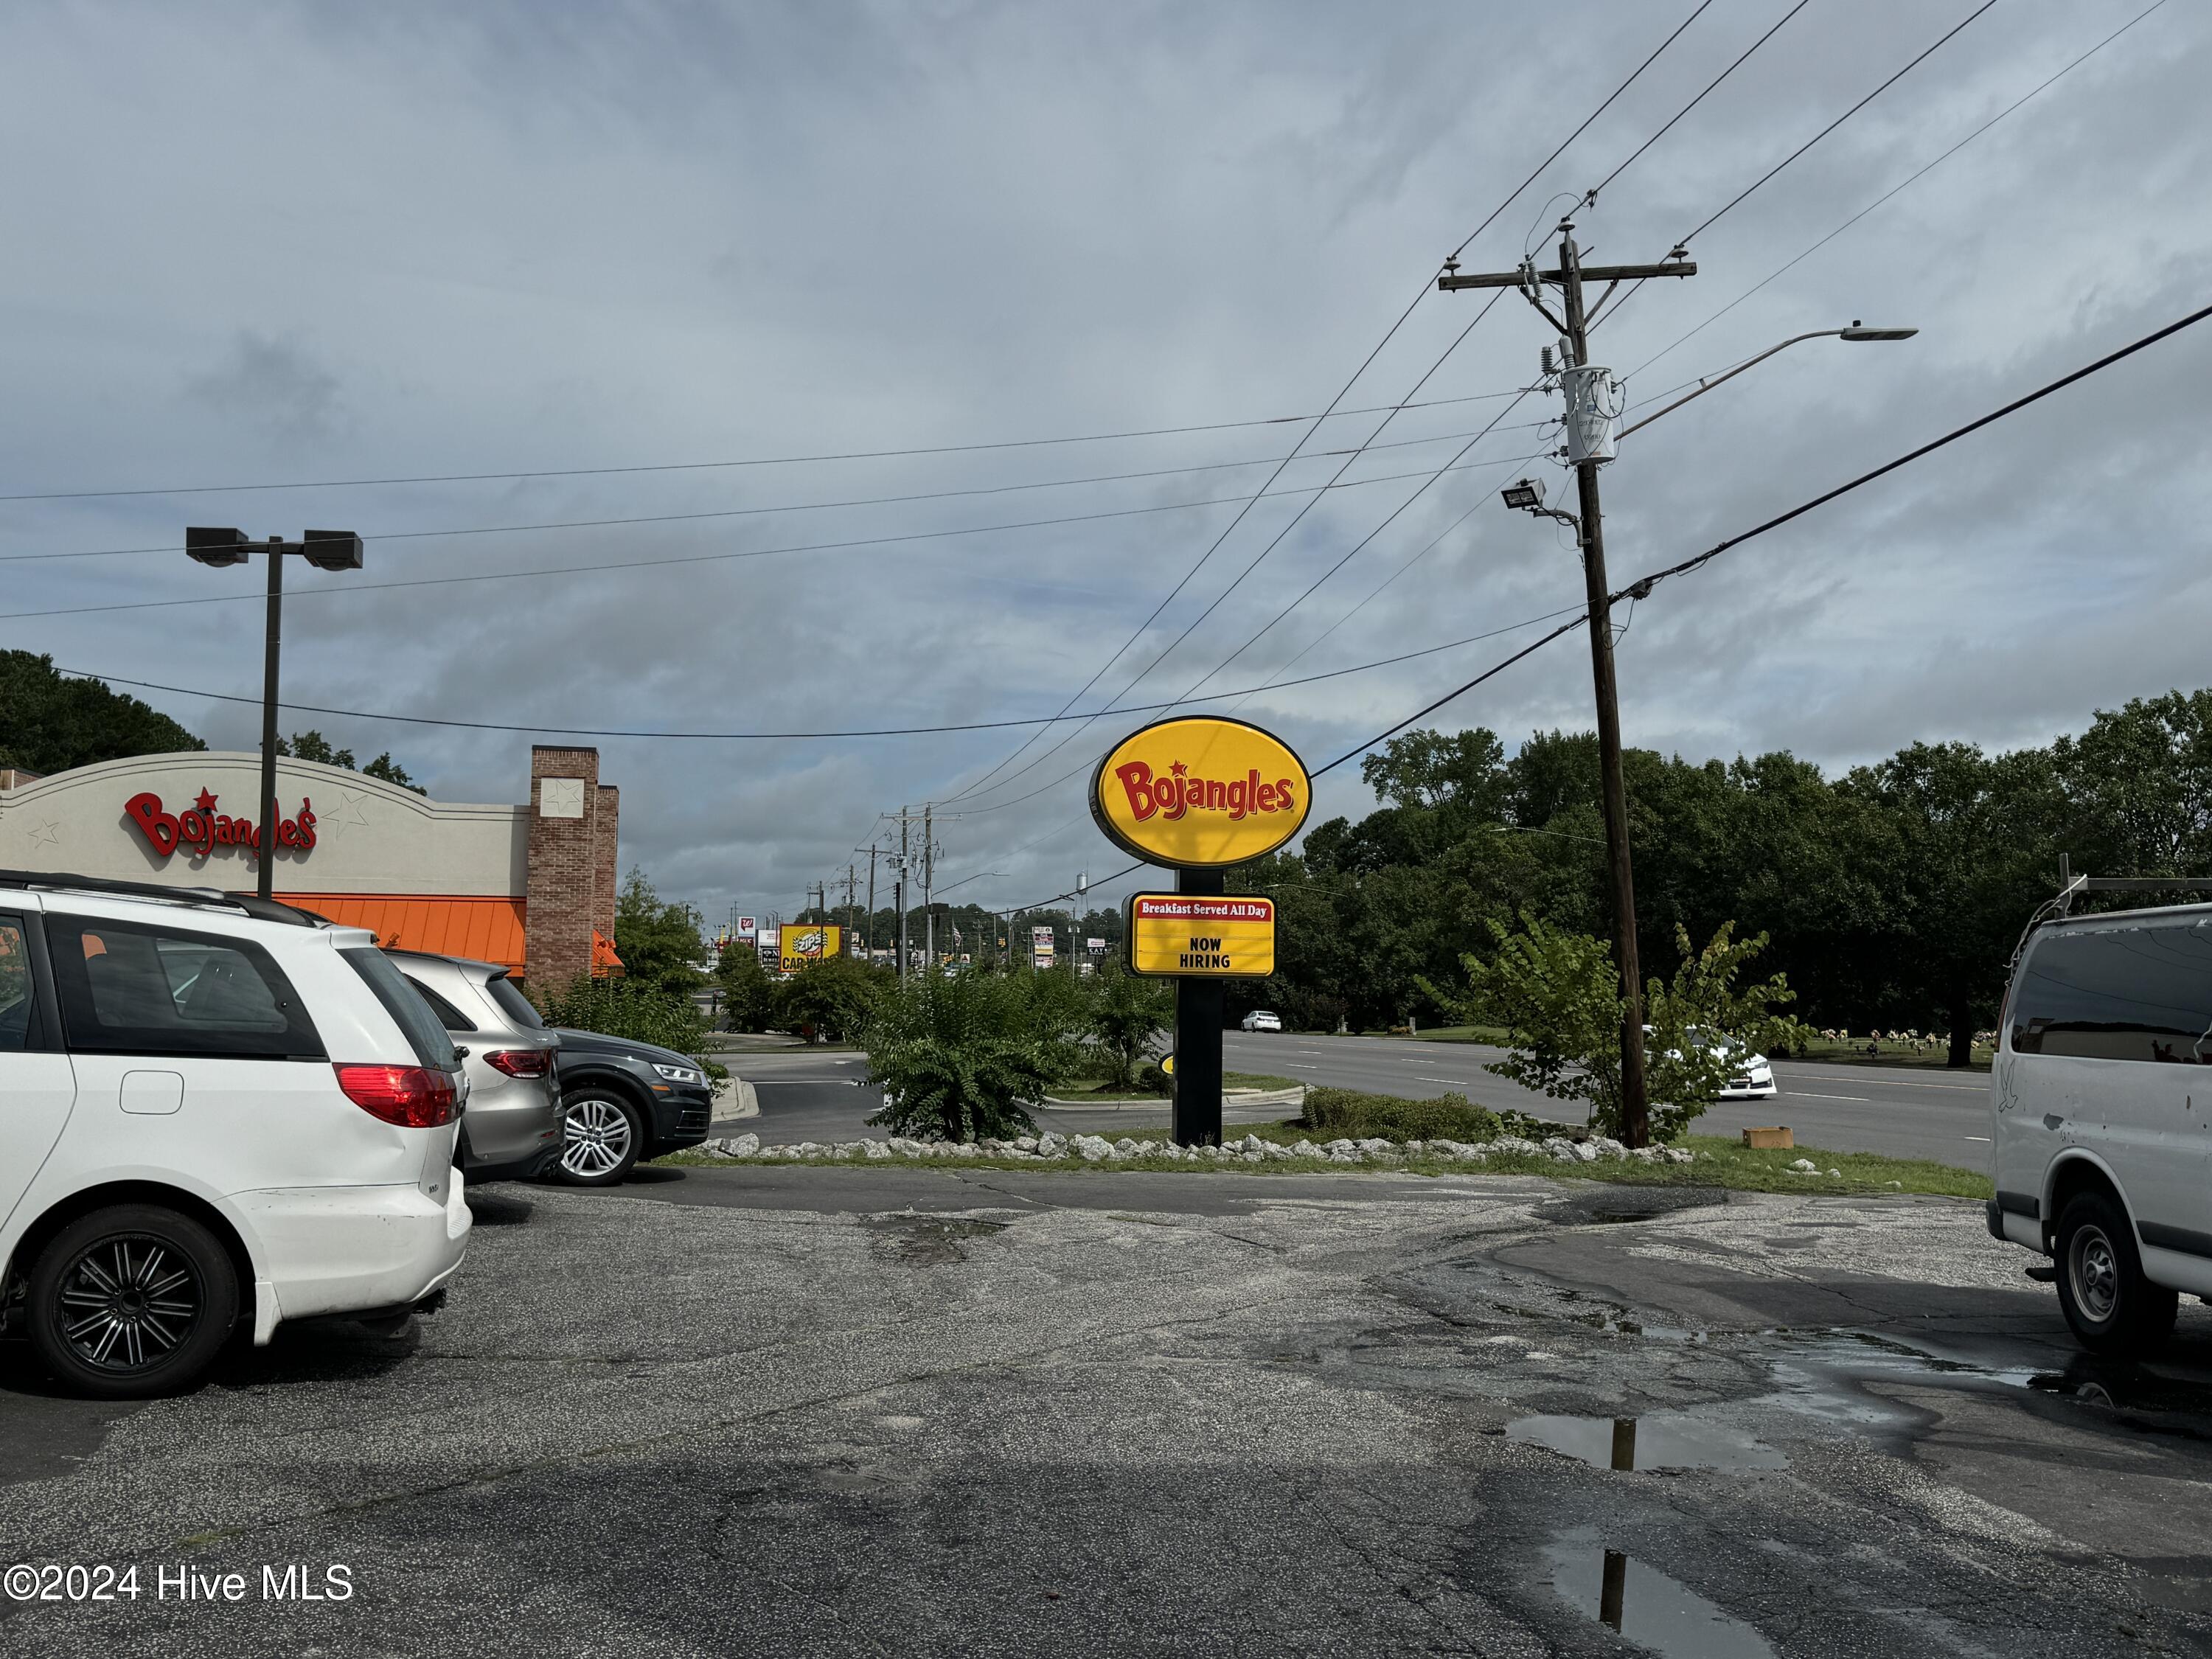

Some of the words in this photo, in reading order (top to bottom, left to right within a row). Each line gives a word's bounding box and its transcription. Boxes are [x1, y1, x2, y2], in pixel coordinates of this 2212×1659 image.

[1115, 760, 1293, 822] Bojangles
[1142, 902, 1192, 914] Breakfast
[1193, 905, 1228, 915] Served
[1230, 905, 1245, 916] All
[1248, 905, 1267, 918] Day
[798, 933, 821, 951] ZIPS
[1190, 938, 1221, 951] NOW
[782, 957, 803, 970] CAR
[1180, 954, 1230, 968] HIRING
